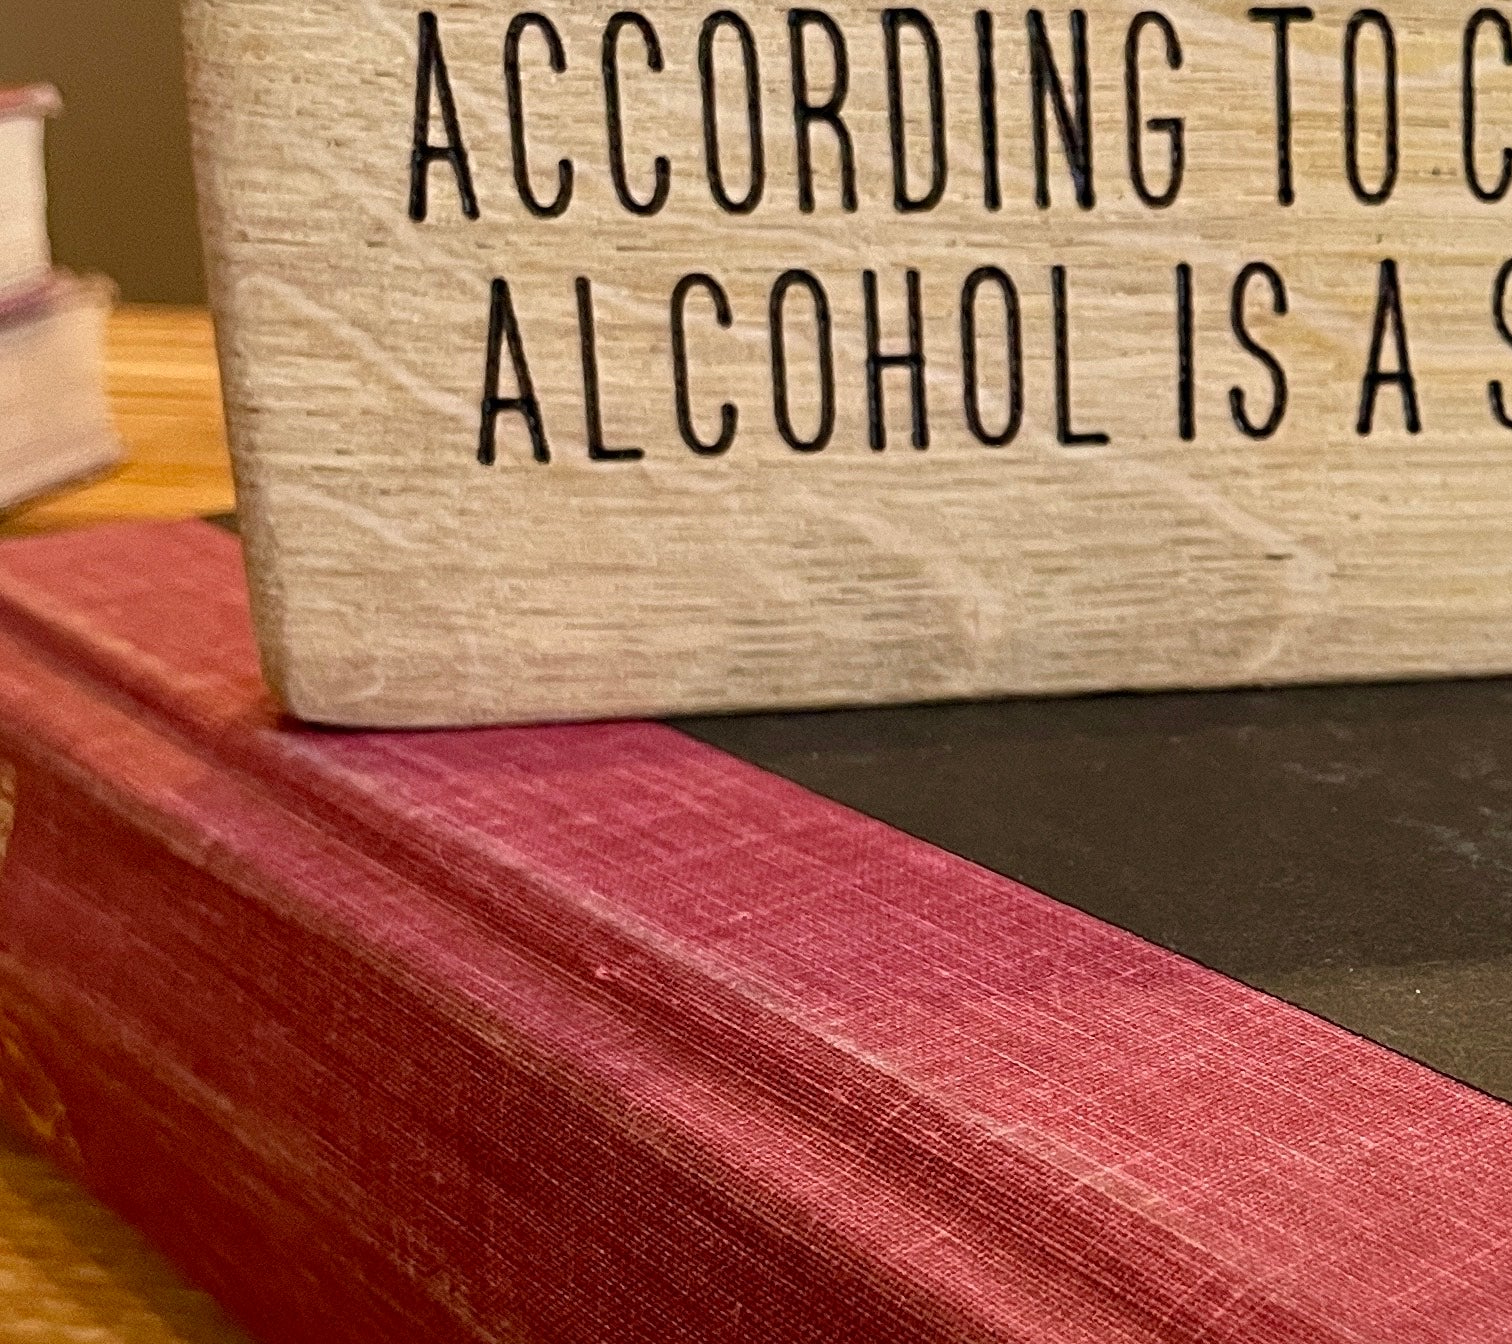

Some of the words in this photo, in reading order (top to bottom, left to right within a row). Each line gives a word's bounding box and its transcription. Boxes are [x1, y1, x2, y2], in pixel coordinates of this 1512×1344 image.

[406, 5, 1187, 224] ACCORDING
[1245, 4, 1401, 209] TO
[475, 263, 1112, 468] ALCOHOL
[1174, 259, 1290, 443] IS
[1354, 256, 1423, 437] A
